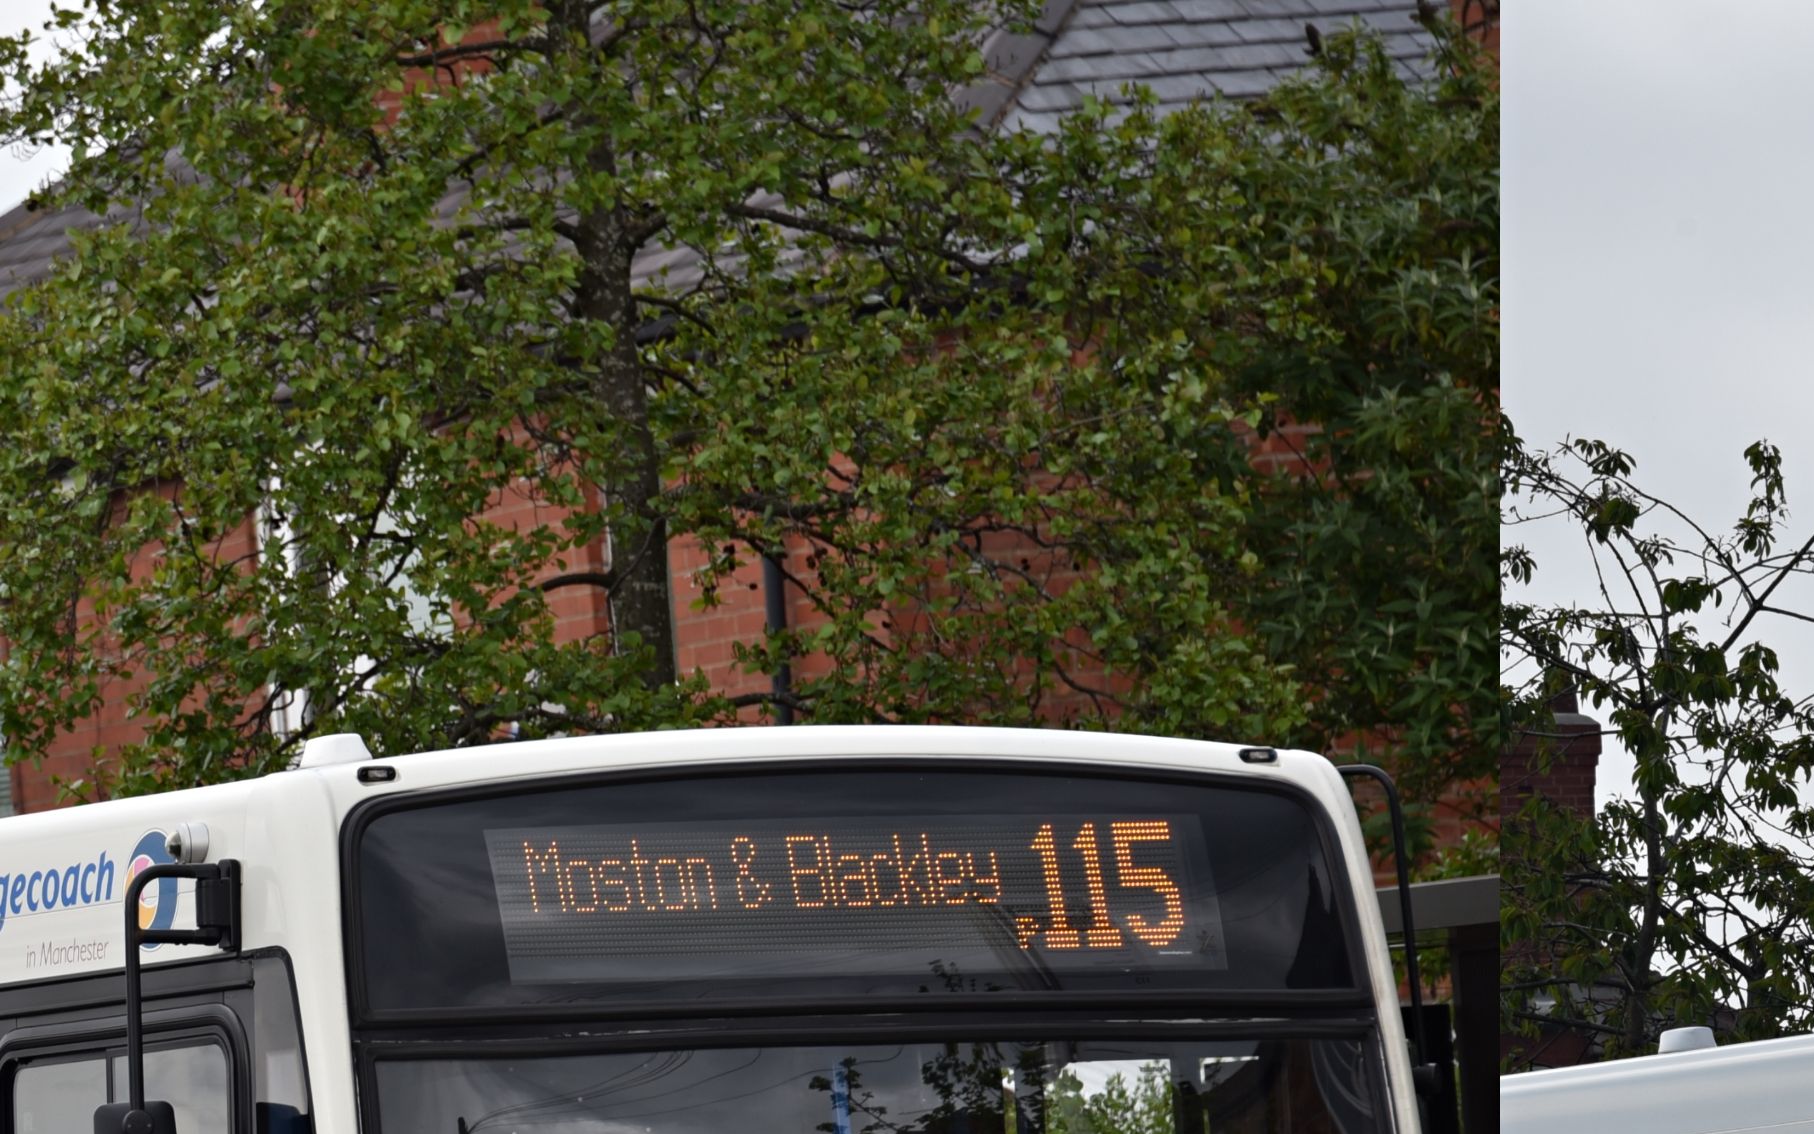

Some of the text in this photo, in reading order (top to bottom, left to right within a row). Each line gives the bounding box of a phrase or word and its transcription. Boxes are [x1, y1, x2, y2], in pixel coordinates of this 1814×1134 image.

[523, 821, 1184, 950] Moston & Blackley 115
[26, 938, 109, 969] in Manchester
